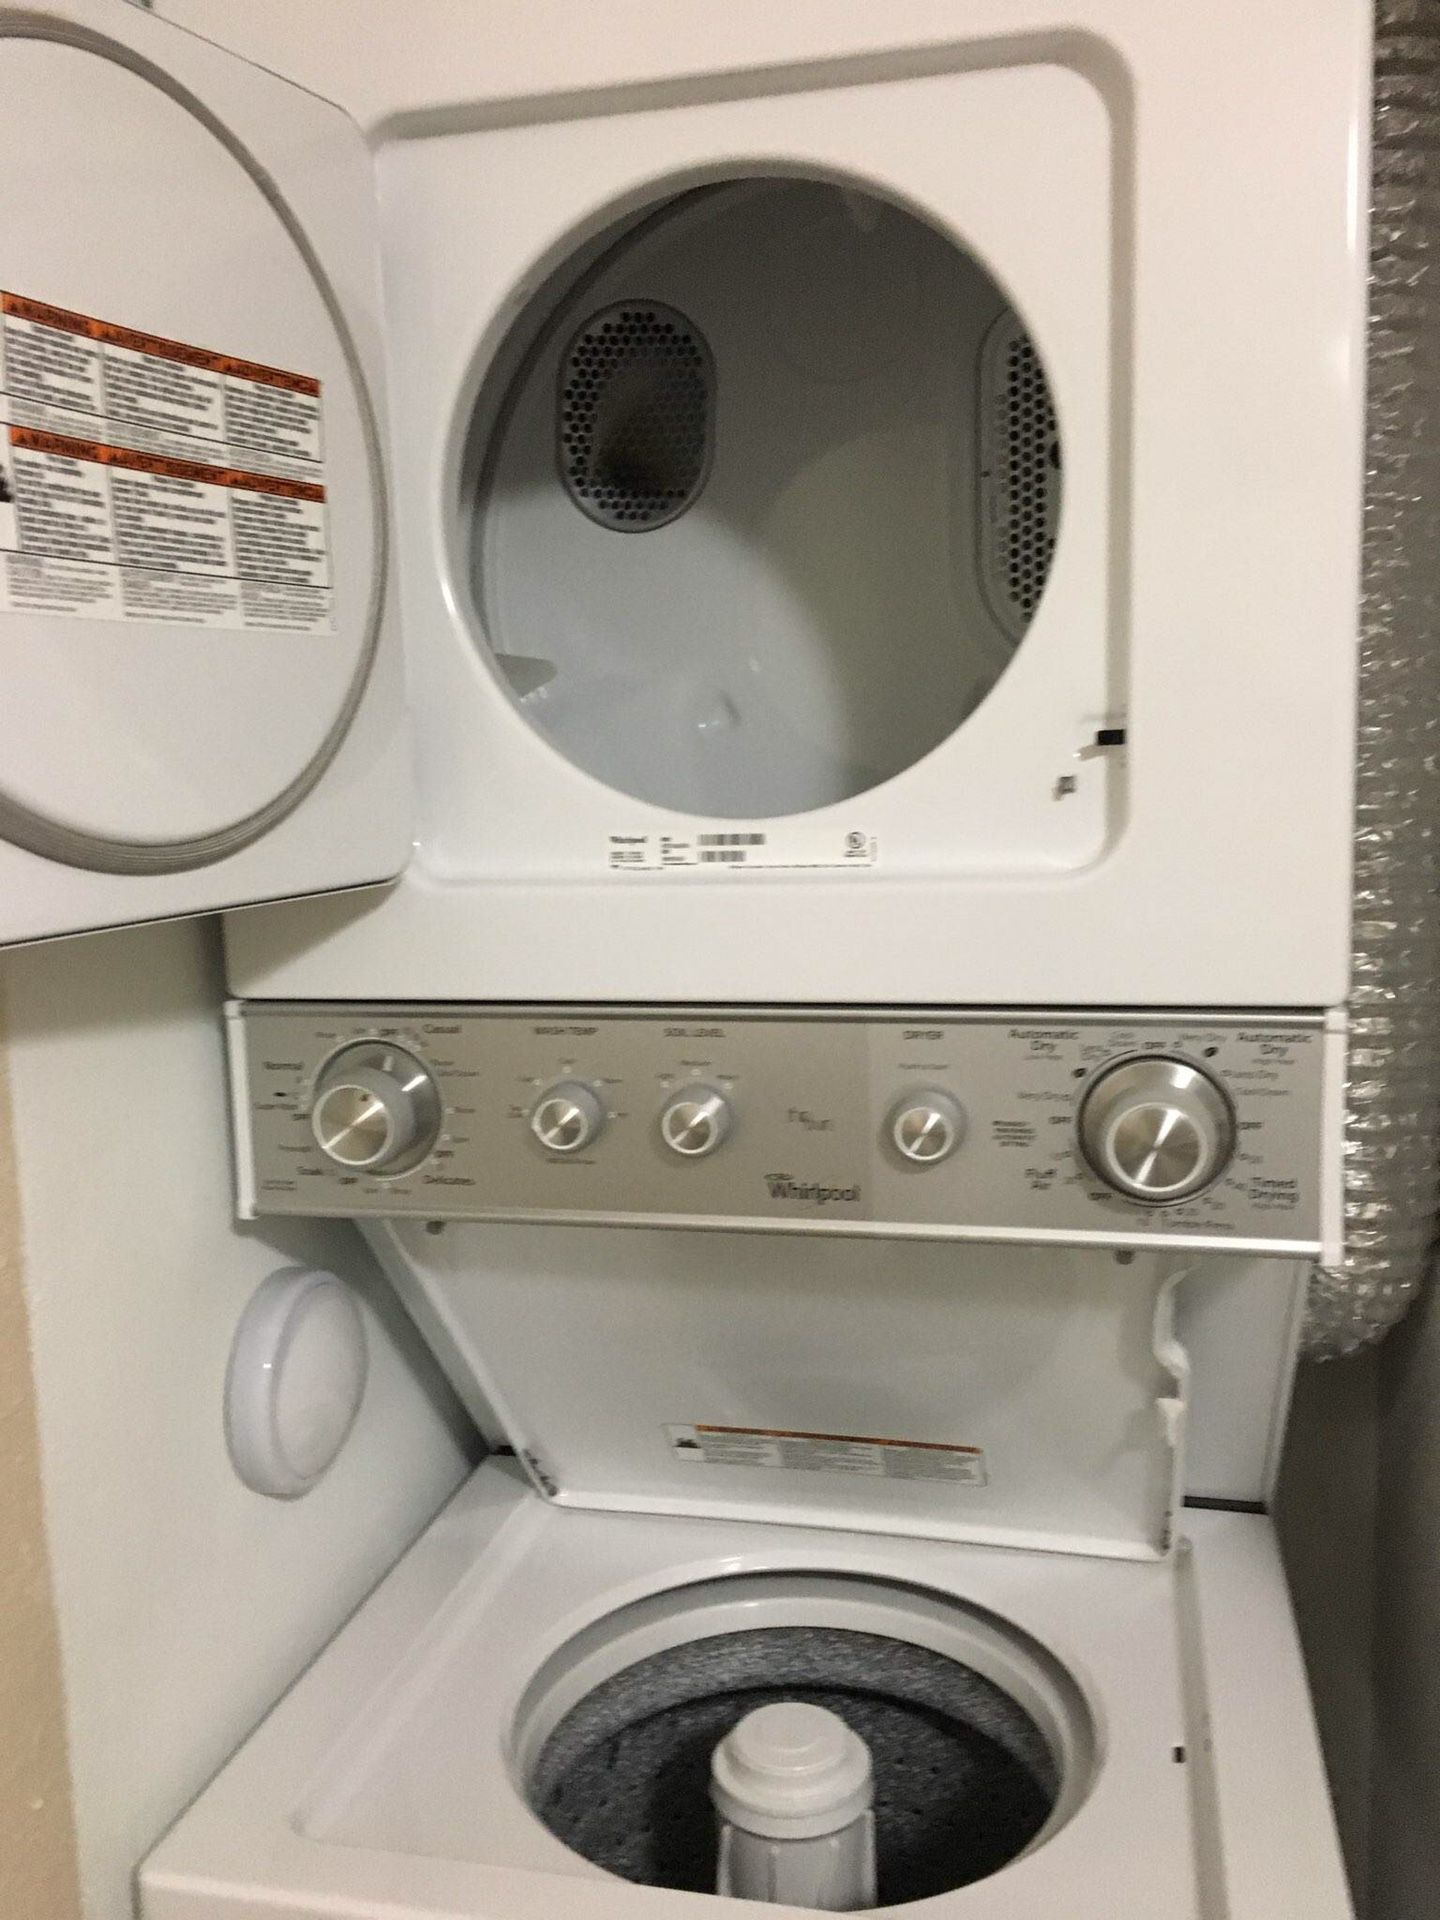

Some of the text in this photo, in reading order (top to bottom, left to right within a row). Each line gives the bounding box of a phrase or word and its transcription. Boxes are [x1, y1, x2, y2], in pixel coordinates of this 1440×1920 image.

[1008, 1029, 1079, 1040] Automatic
[1236, 1032, 1313, 1043] Automatic
[768, 1182, 861, 1205] Whirlpool
